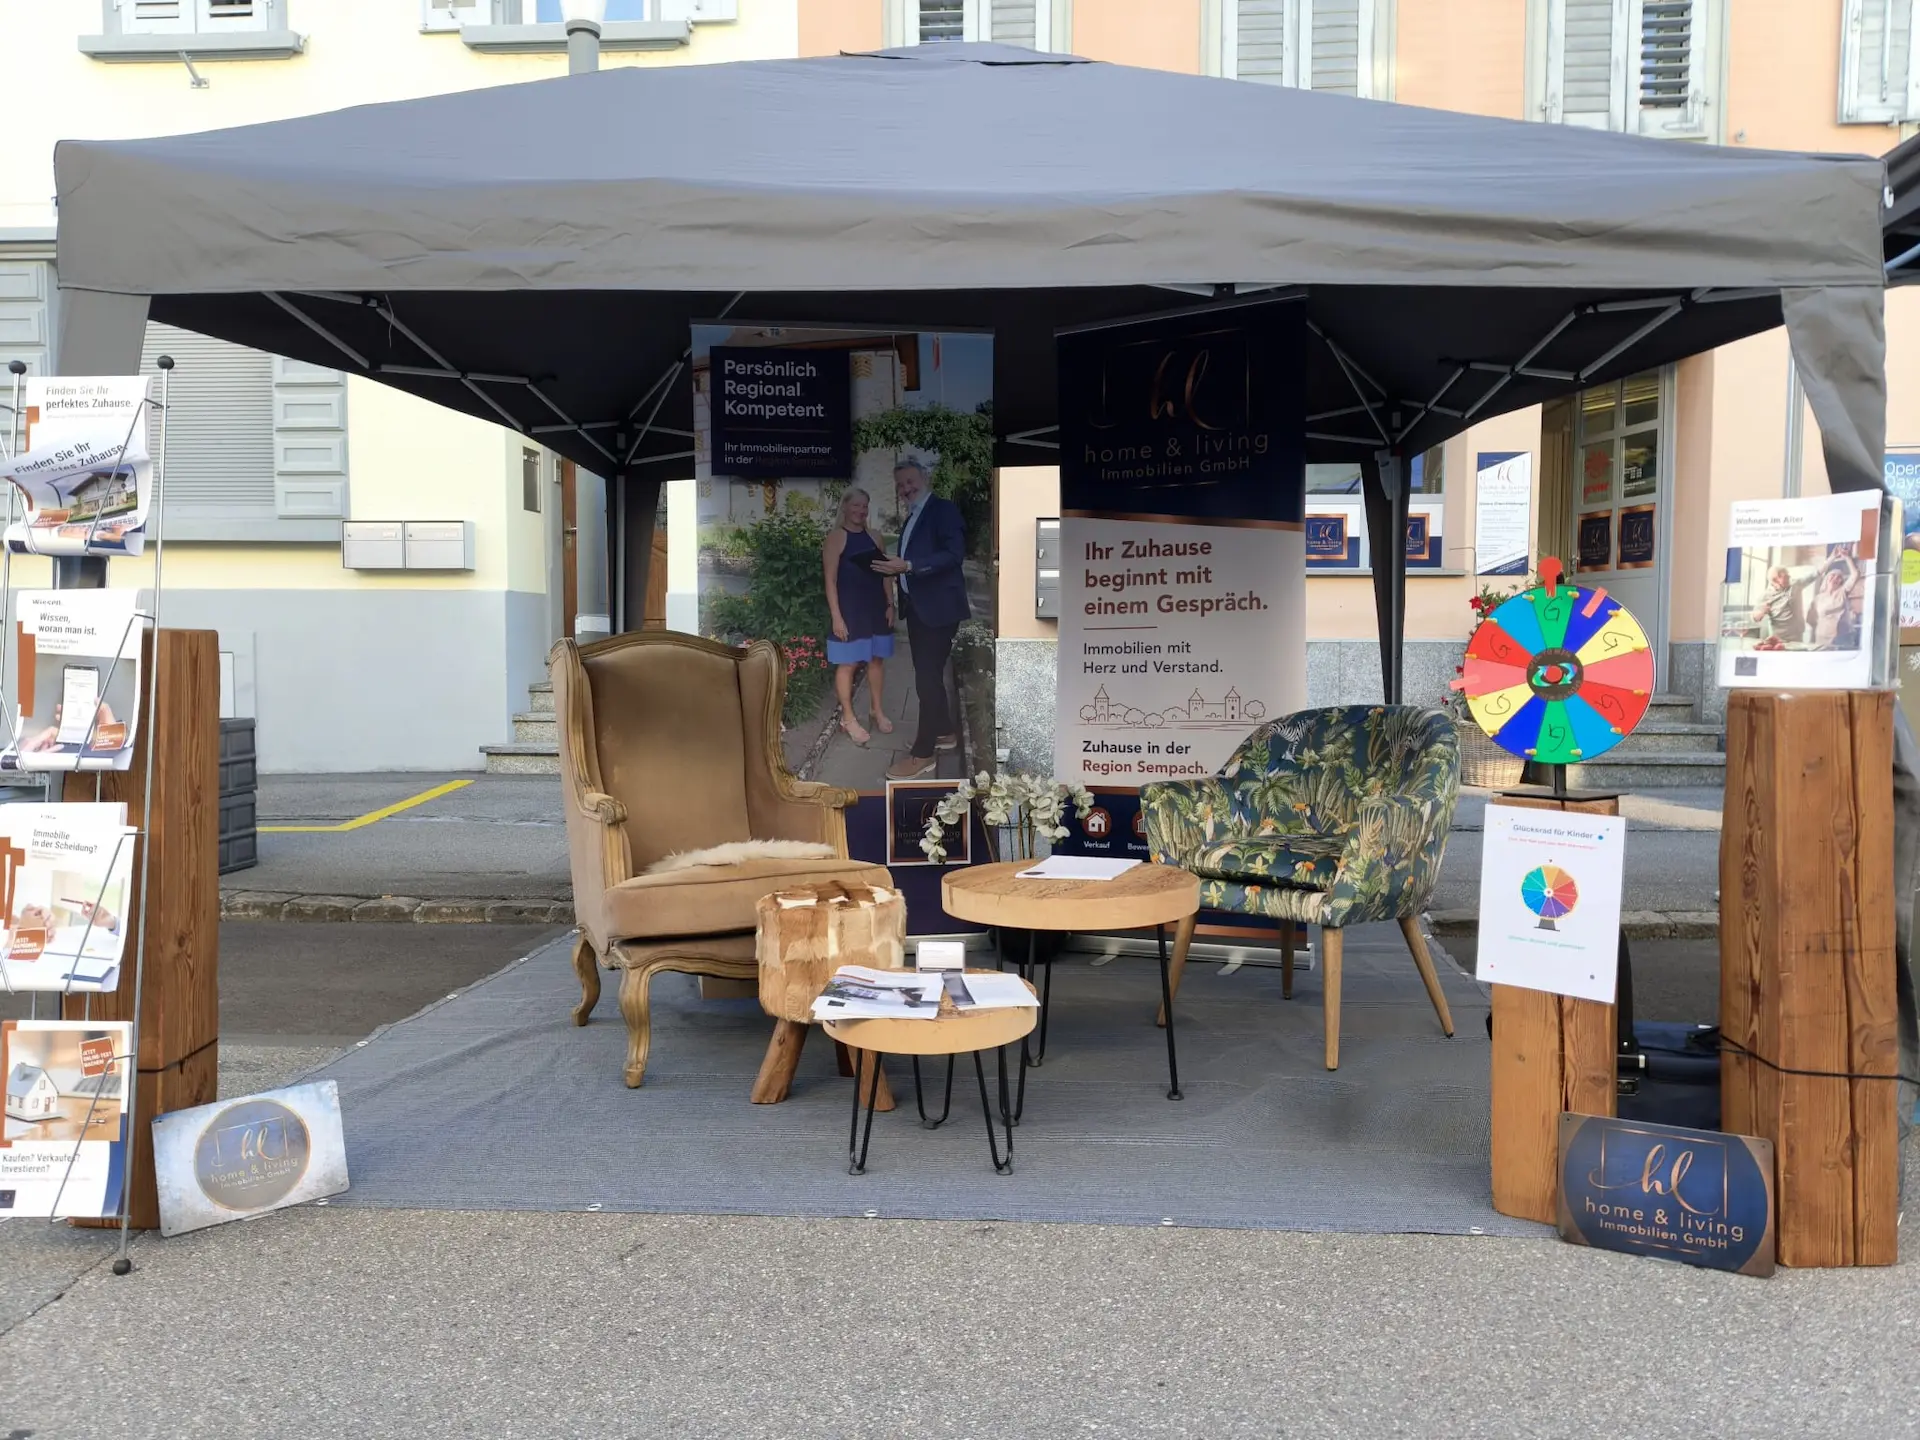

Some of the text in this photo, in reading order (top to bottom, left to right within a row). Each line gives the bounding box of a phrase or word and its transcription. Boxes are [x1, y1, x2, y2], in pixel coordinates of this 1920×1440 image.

[46, 386, 109, 396] Finden Sie Ihr
[46, 398, 133, 411] perfektes Zuhause.
[55, 448, 75, 462] Sie
[74, 441, 92, 455] Ihr
[724, 442, 832, 456] Ihr Immobilienpartner
[1085, 432, 1269, 464] home & living
[724, 455, 734, 464] in
[736, 455, 754, 464] der
[1101, 456, 1250, 480] Immobilien GmbH
[1736, 517, 1768, 525] Wohnen
[1085, 538, 1212, 560] Ihr Zuhause
[1085, 565, 1212, 592] beginnt mit
[1084, 590, 1268, 617] einem Gespräch.
[40, 612, 71, 624] Wissen,
[38, 625, 97, 636] woran man ist.
[1083, 641, 1192, 655] Immobilien mit
[1083, 659, 1223, 674] Herz und Verstand.
[1082, 740, 1191, 754] Zuhause in der
[1083, 759, 1208, 777] Region Sempach.
[33, 829, 70, 840] Immobilie
[1513, 824, 1594, 839] Glücksrad für Kinder
[32, 839, 98, 854] in der Scheidung?
[1083, 841, 1111, 849] Verkauf
[3, 1153, 35, 1163] Kaufen?
[1, 1164, 50, 1174] Investieren?
[211, 1158, 298, 1183] home & living
[220, 1168, 291, 1189] Immobilien GmbH
[1585, 1197, 1744, 1241] home & living
[1600, 1219, 1728, 1249] Immobilien GmbH
